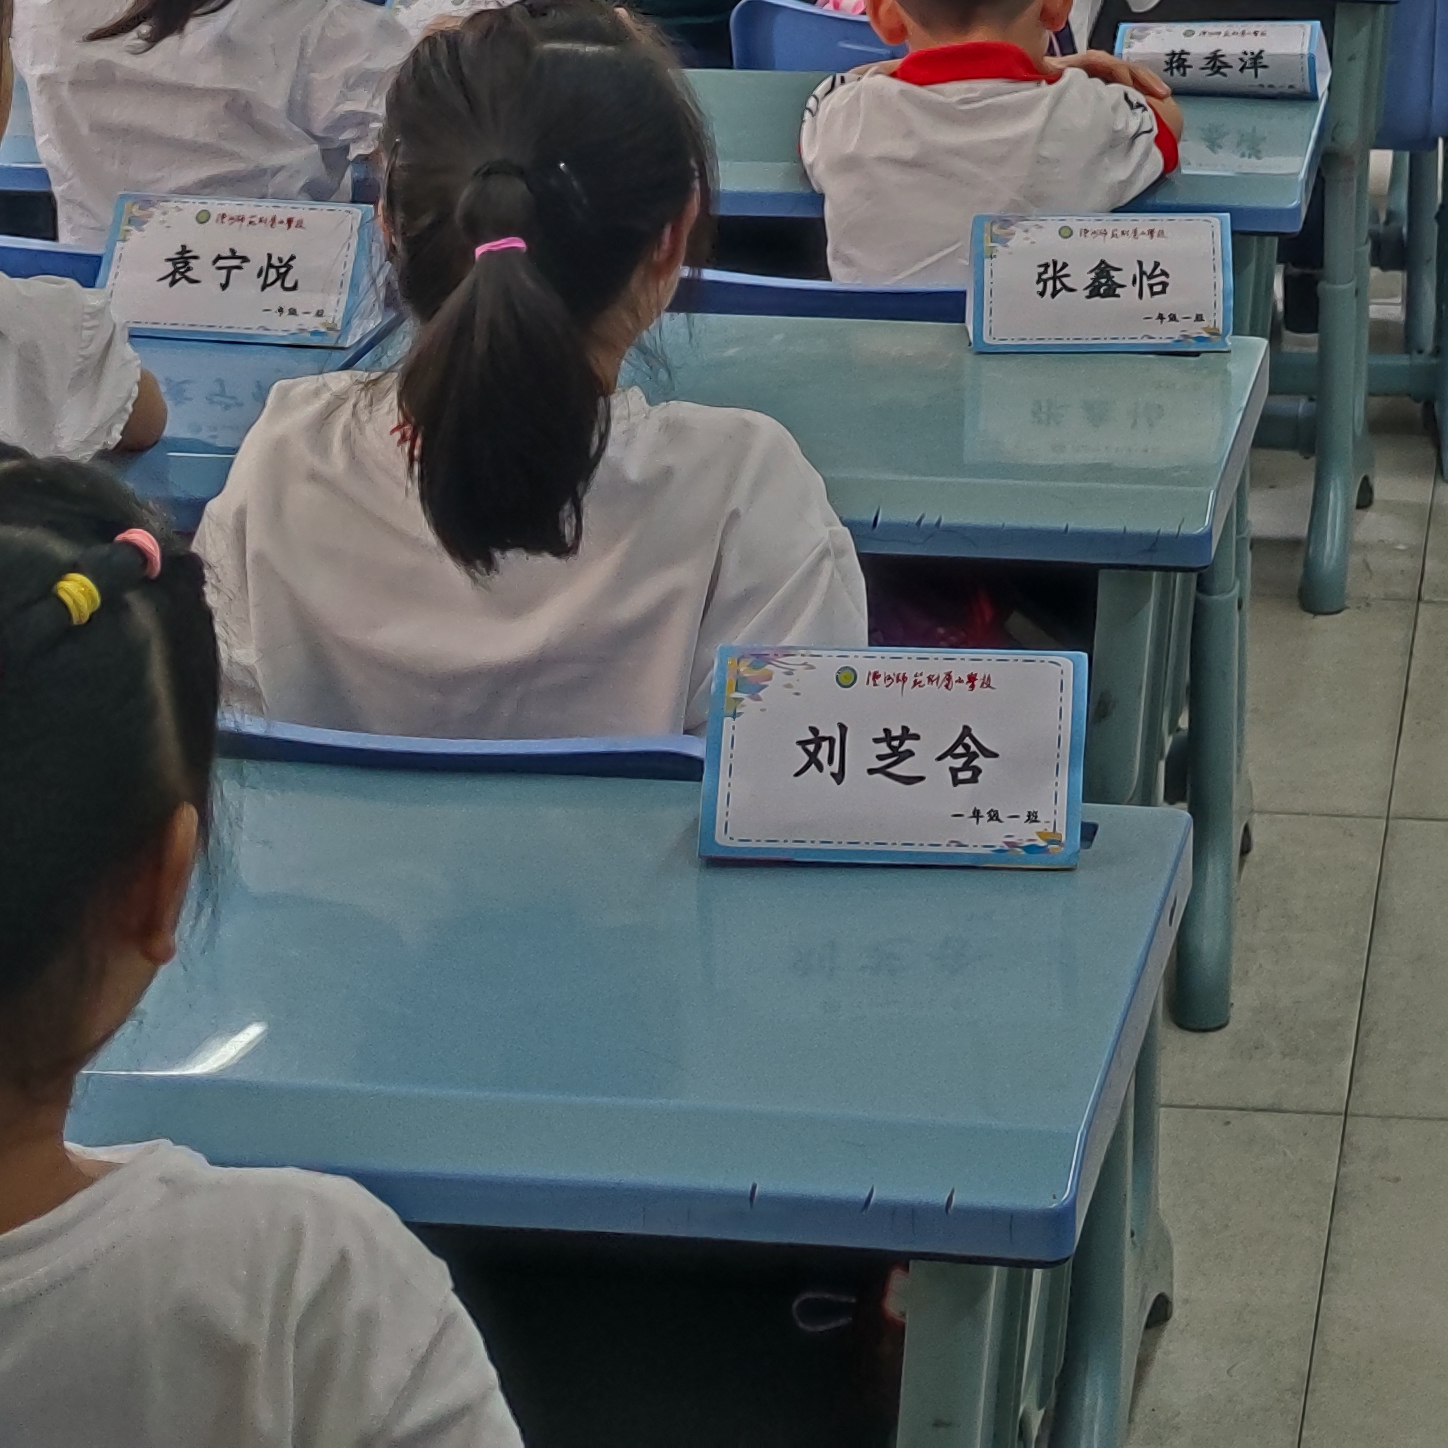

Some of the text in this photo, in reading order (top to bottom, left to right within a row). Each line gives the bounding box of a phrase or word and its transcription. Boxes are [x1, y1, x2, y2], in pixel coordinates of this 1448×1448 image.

[157, 245, 298, 292] 袁宁悦
[1036, 259, 1169, 300] 张鑫怡
[1143, 313, 1205, 323] 一年级一班
[793, 722, 1000, 787] 刘芝含
[951, 807, 1042, 825] 一年级一班
